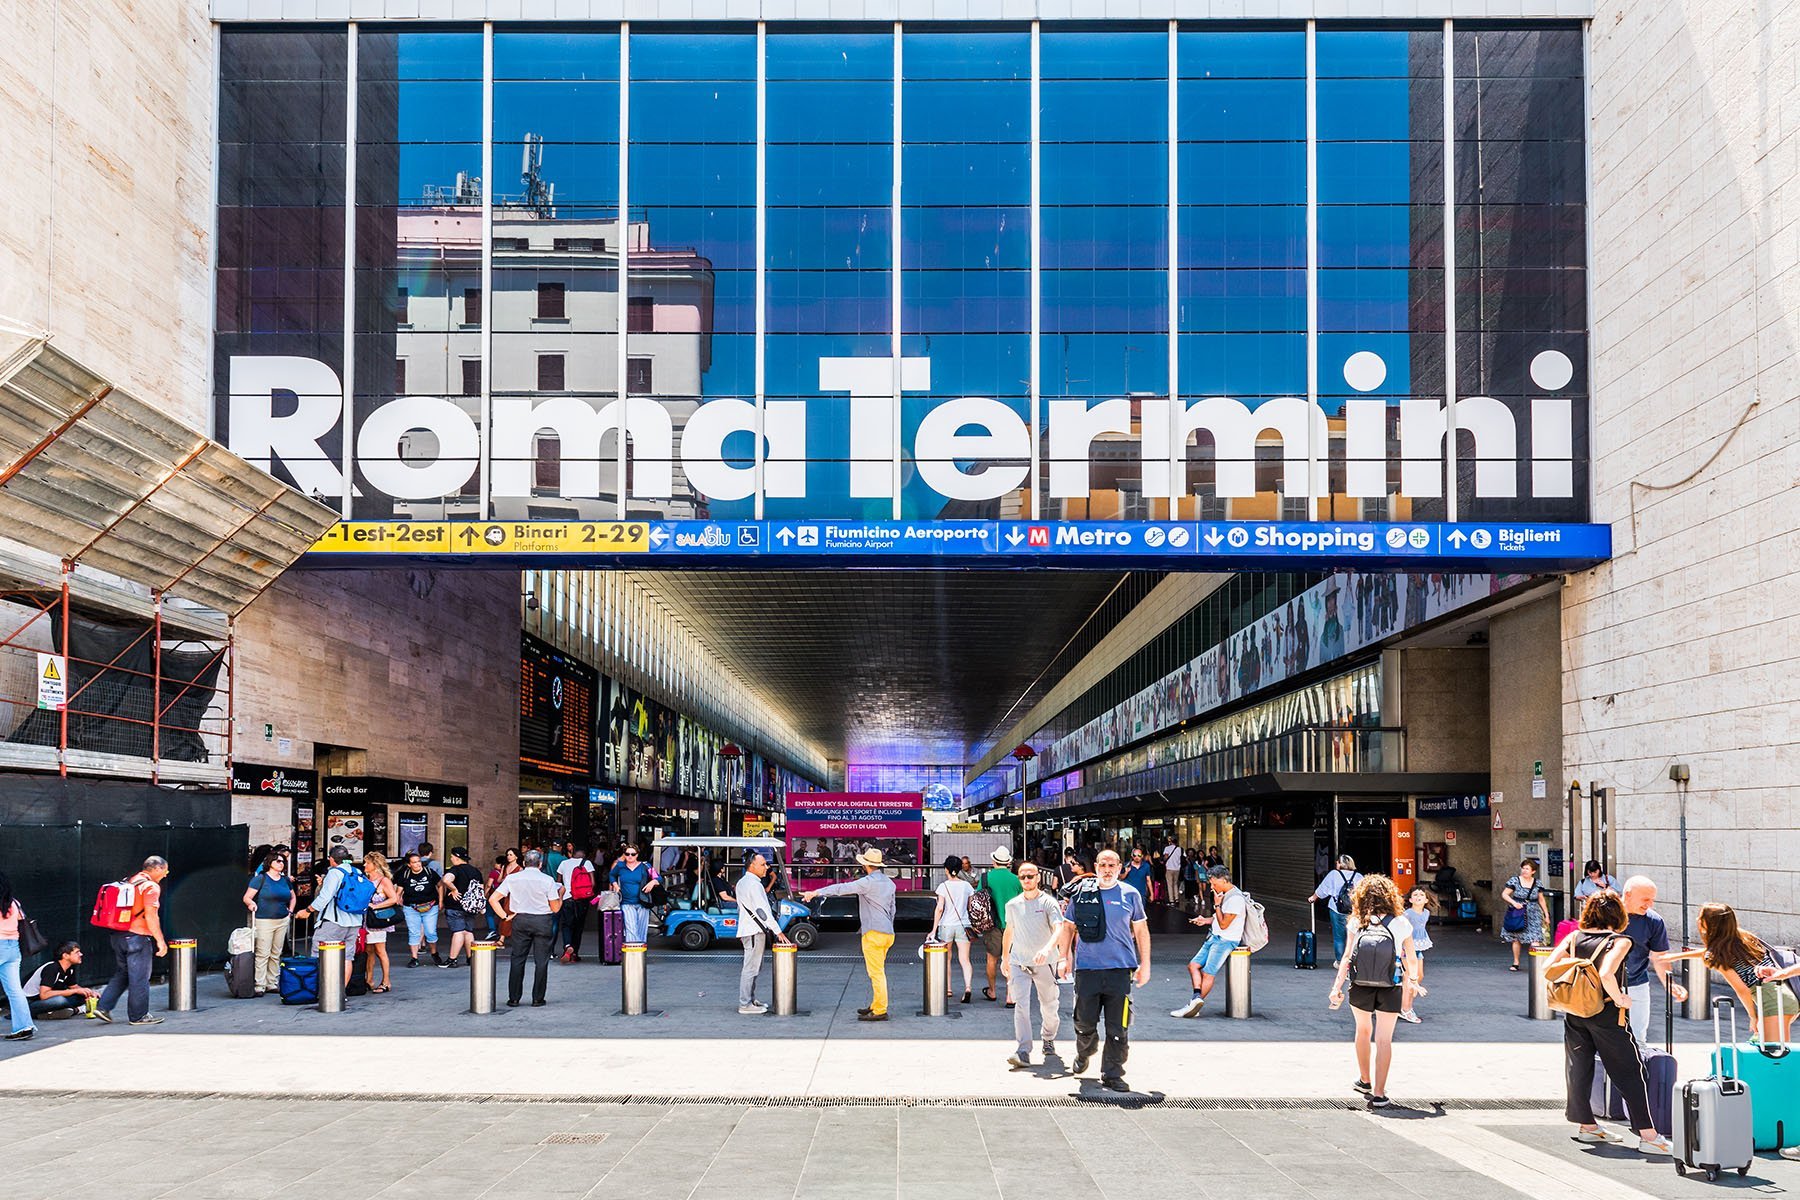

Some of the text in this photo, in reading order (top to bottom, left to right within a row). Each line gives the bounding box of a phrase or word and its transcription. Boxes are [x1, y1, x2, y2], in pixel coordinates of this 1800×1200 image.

[317, 523, 445, 542] -1est-2est
[513, 525, 644, 543] Binari 2-29
[825, 525, 989, 541] Fiumicino Aeroporto
[1055, 526, 1132, 545] Metro
[1254, 526, 1375, 551] Shopping
[1498, 529, 1561, 544] Biglietti
[513, 541, 559, 552] Platforms
[825, 539, 894, 550] Fiumicino Airport
[1498, 543, 1526, 552] Tickets
[234, 779, 250, 790] Pizza
[326, 786, 352, 794] Coffee
[404, 782, 430, 803] Roadhouse
[1420, 798, 1458, 810] Ascensore/Lift
[1346, 818, 1386, 826] VyTA
